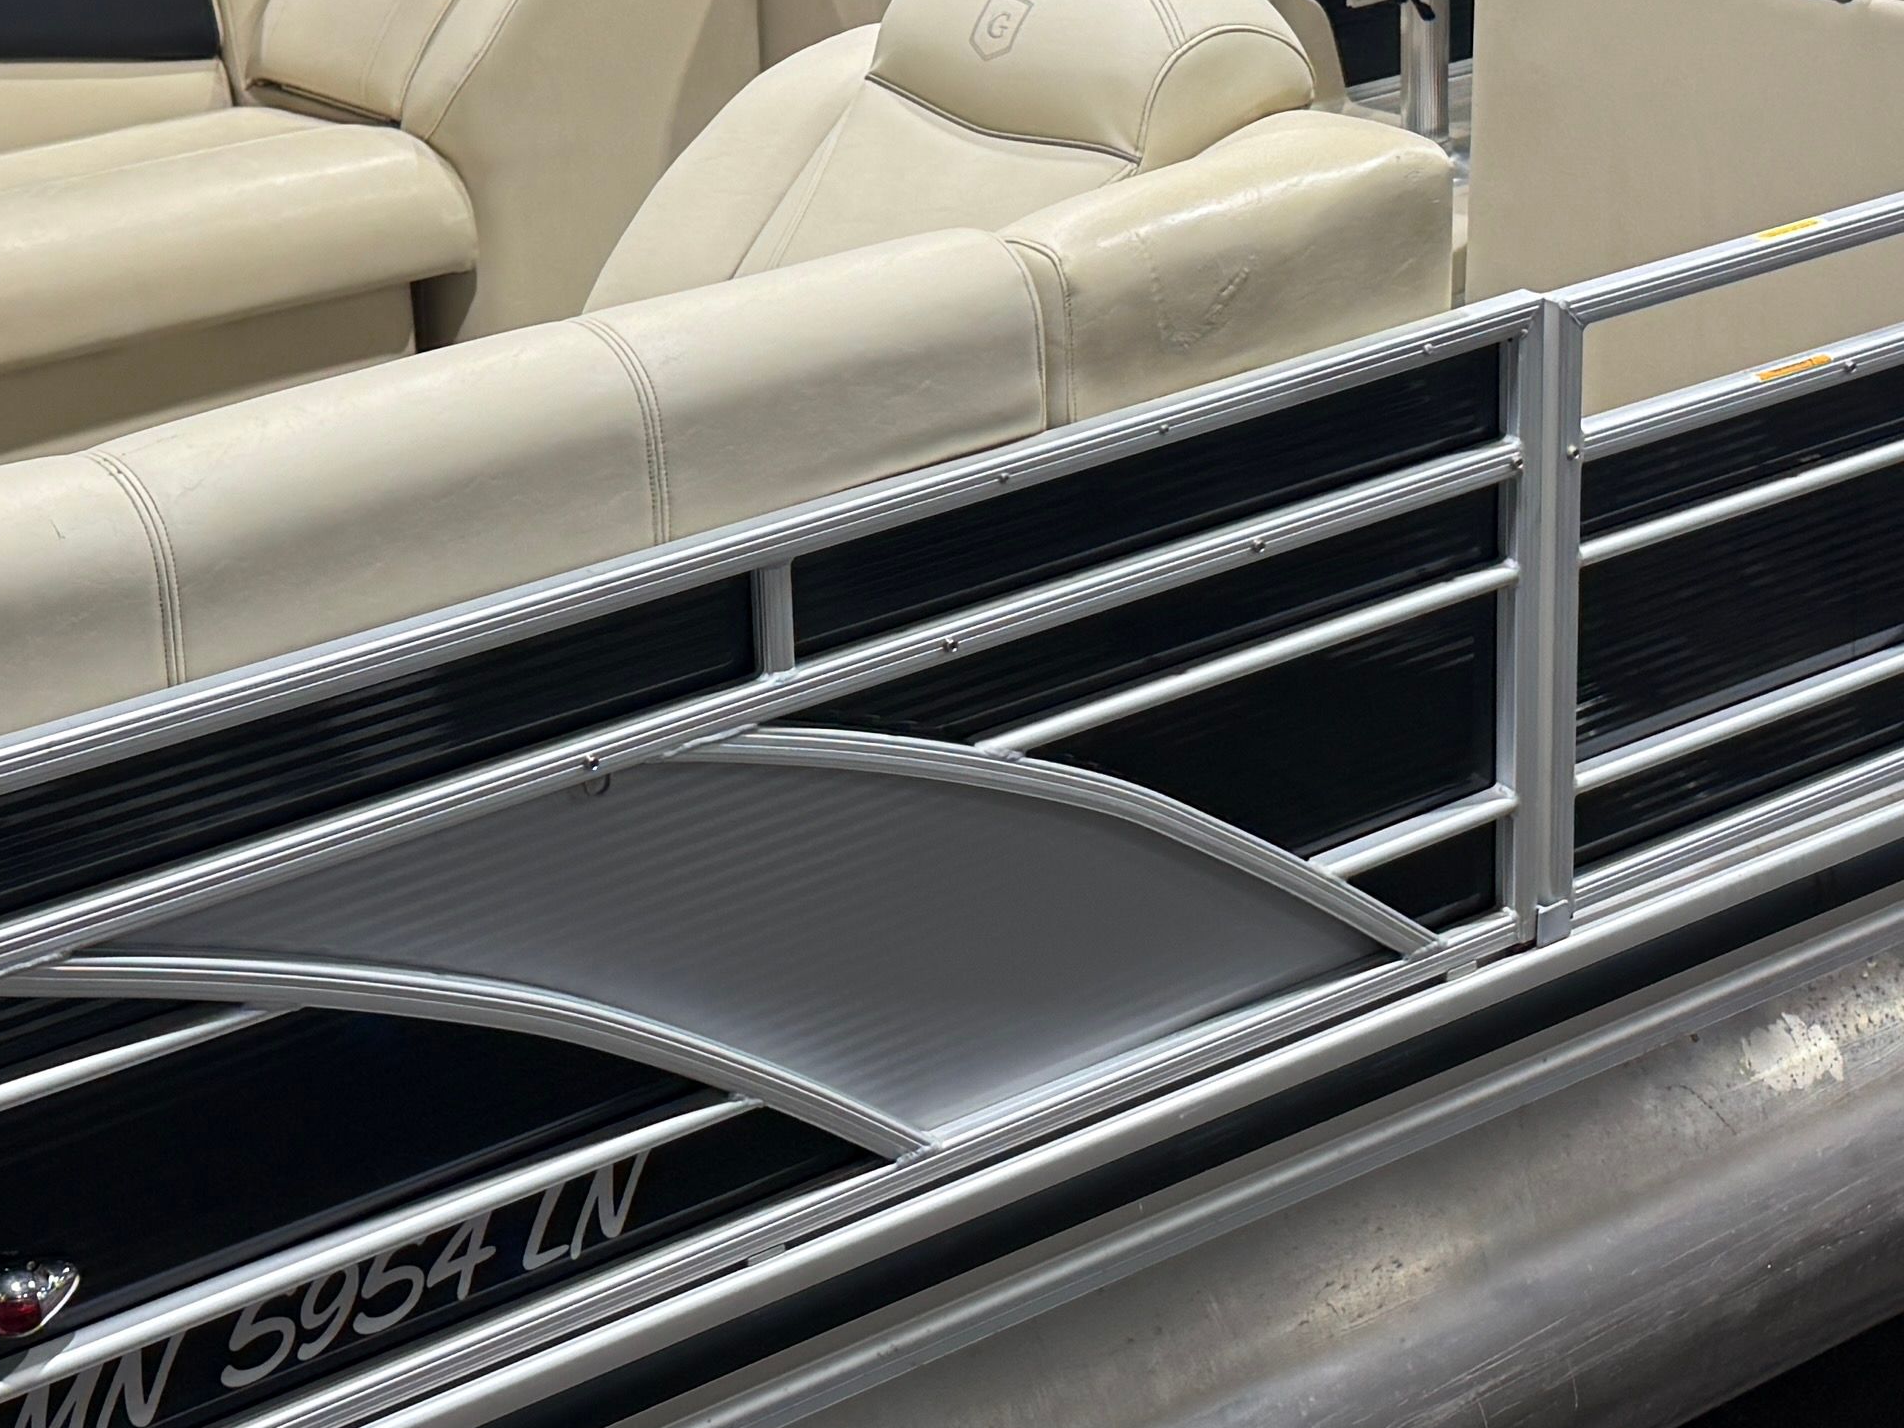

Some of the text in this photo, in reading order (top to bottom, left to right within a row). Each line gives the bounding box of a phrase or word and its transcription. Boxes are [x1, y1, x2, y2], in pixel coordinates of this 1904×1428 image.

[985, 11, 1013, 40] G
[220, 1210, 498, 1389] 5954
[520, 1150, 657, 1274] LN
